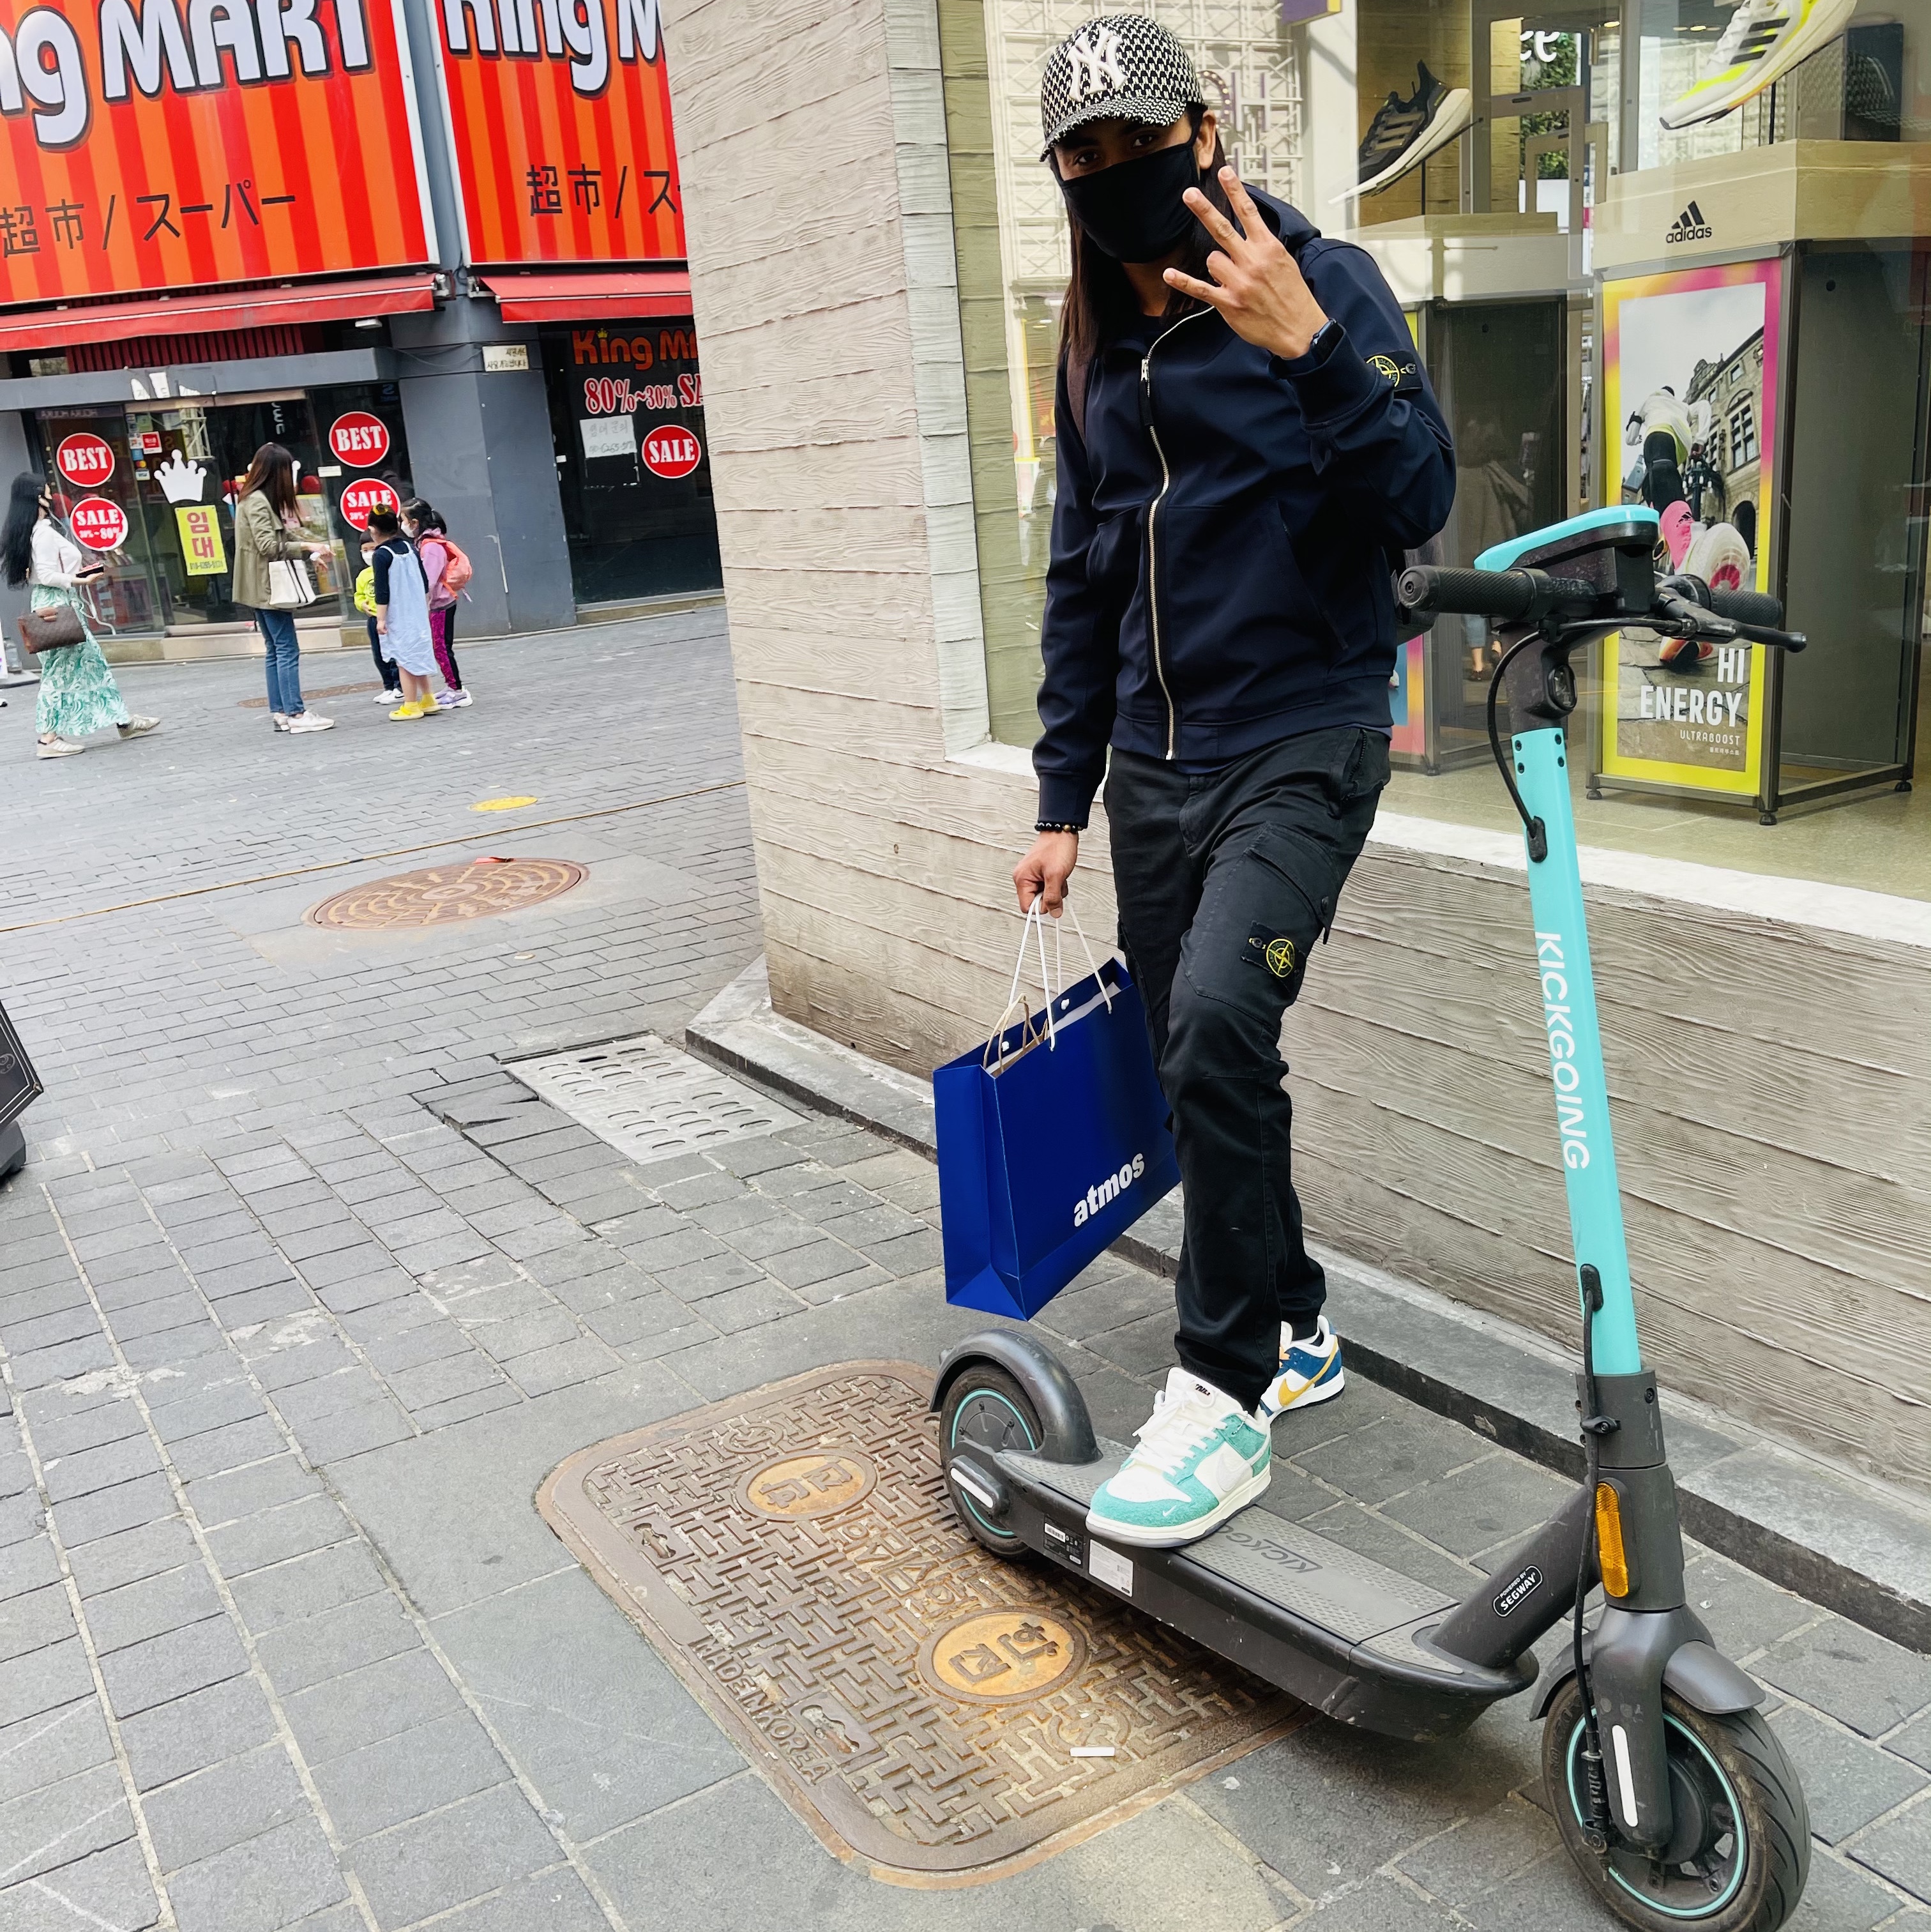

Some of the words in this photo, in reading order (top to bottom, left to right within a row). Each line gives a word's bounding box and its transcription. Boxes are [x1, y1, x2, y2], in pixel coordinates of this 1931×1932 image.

[1067, 27, 1128, 103] NY
[1665, 225, 1713, 244] adidas
[572, 330, 654, 370] King
[335, 425, 382, 452] BEST
[648, 437, 695, 464] SALE
[63, 446, 109, 472] BEST
[75, 508, 120, 526] SALE
[346, 489, 393, 508] SALE
[186, 512, 215, 558] 임대
[1716, 647, 1745, 684] HI
[1640, 685, 1743, 727] ENERGY
[1679, 729, 1741, 747] ULTRABOOST
[1534, 931, 1590, 1170] KICKGOING
[1073, 1153, 1145, 1227] atmos
[693, 1637, 757, 1696] MADE
[753, 1707, 833, 1786] KOREA
